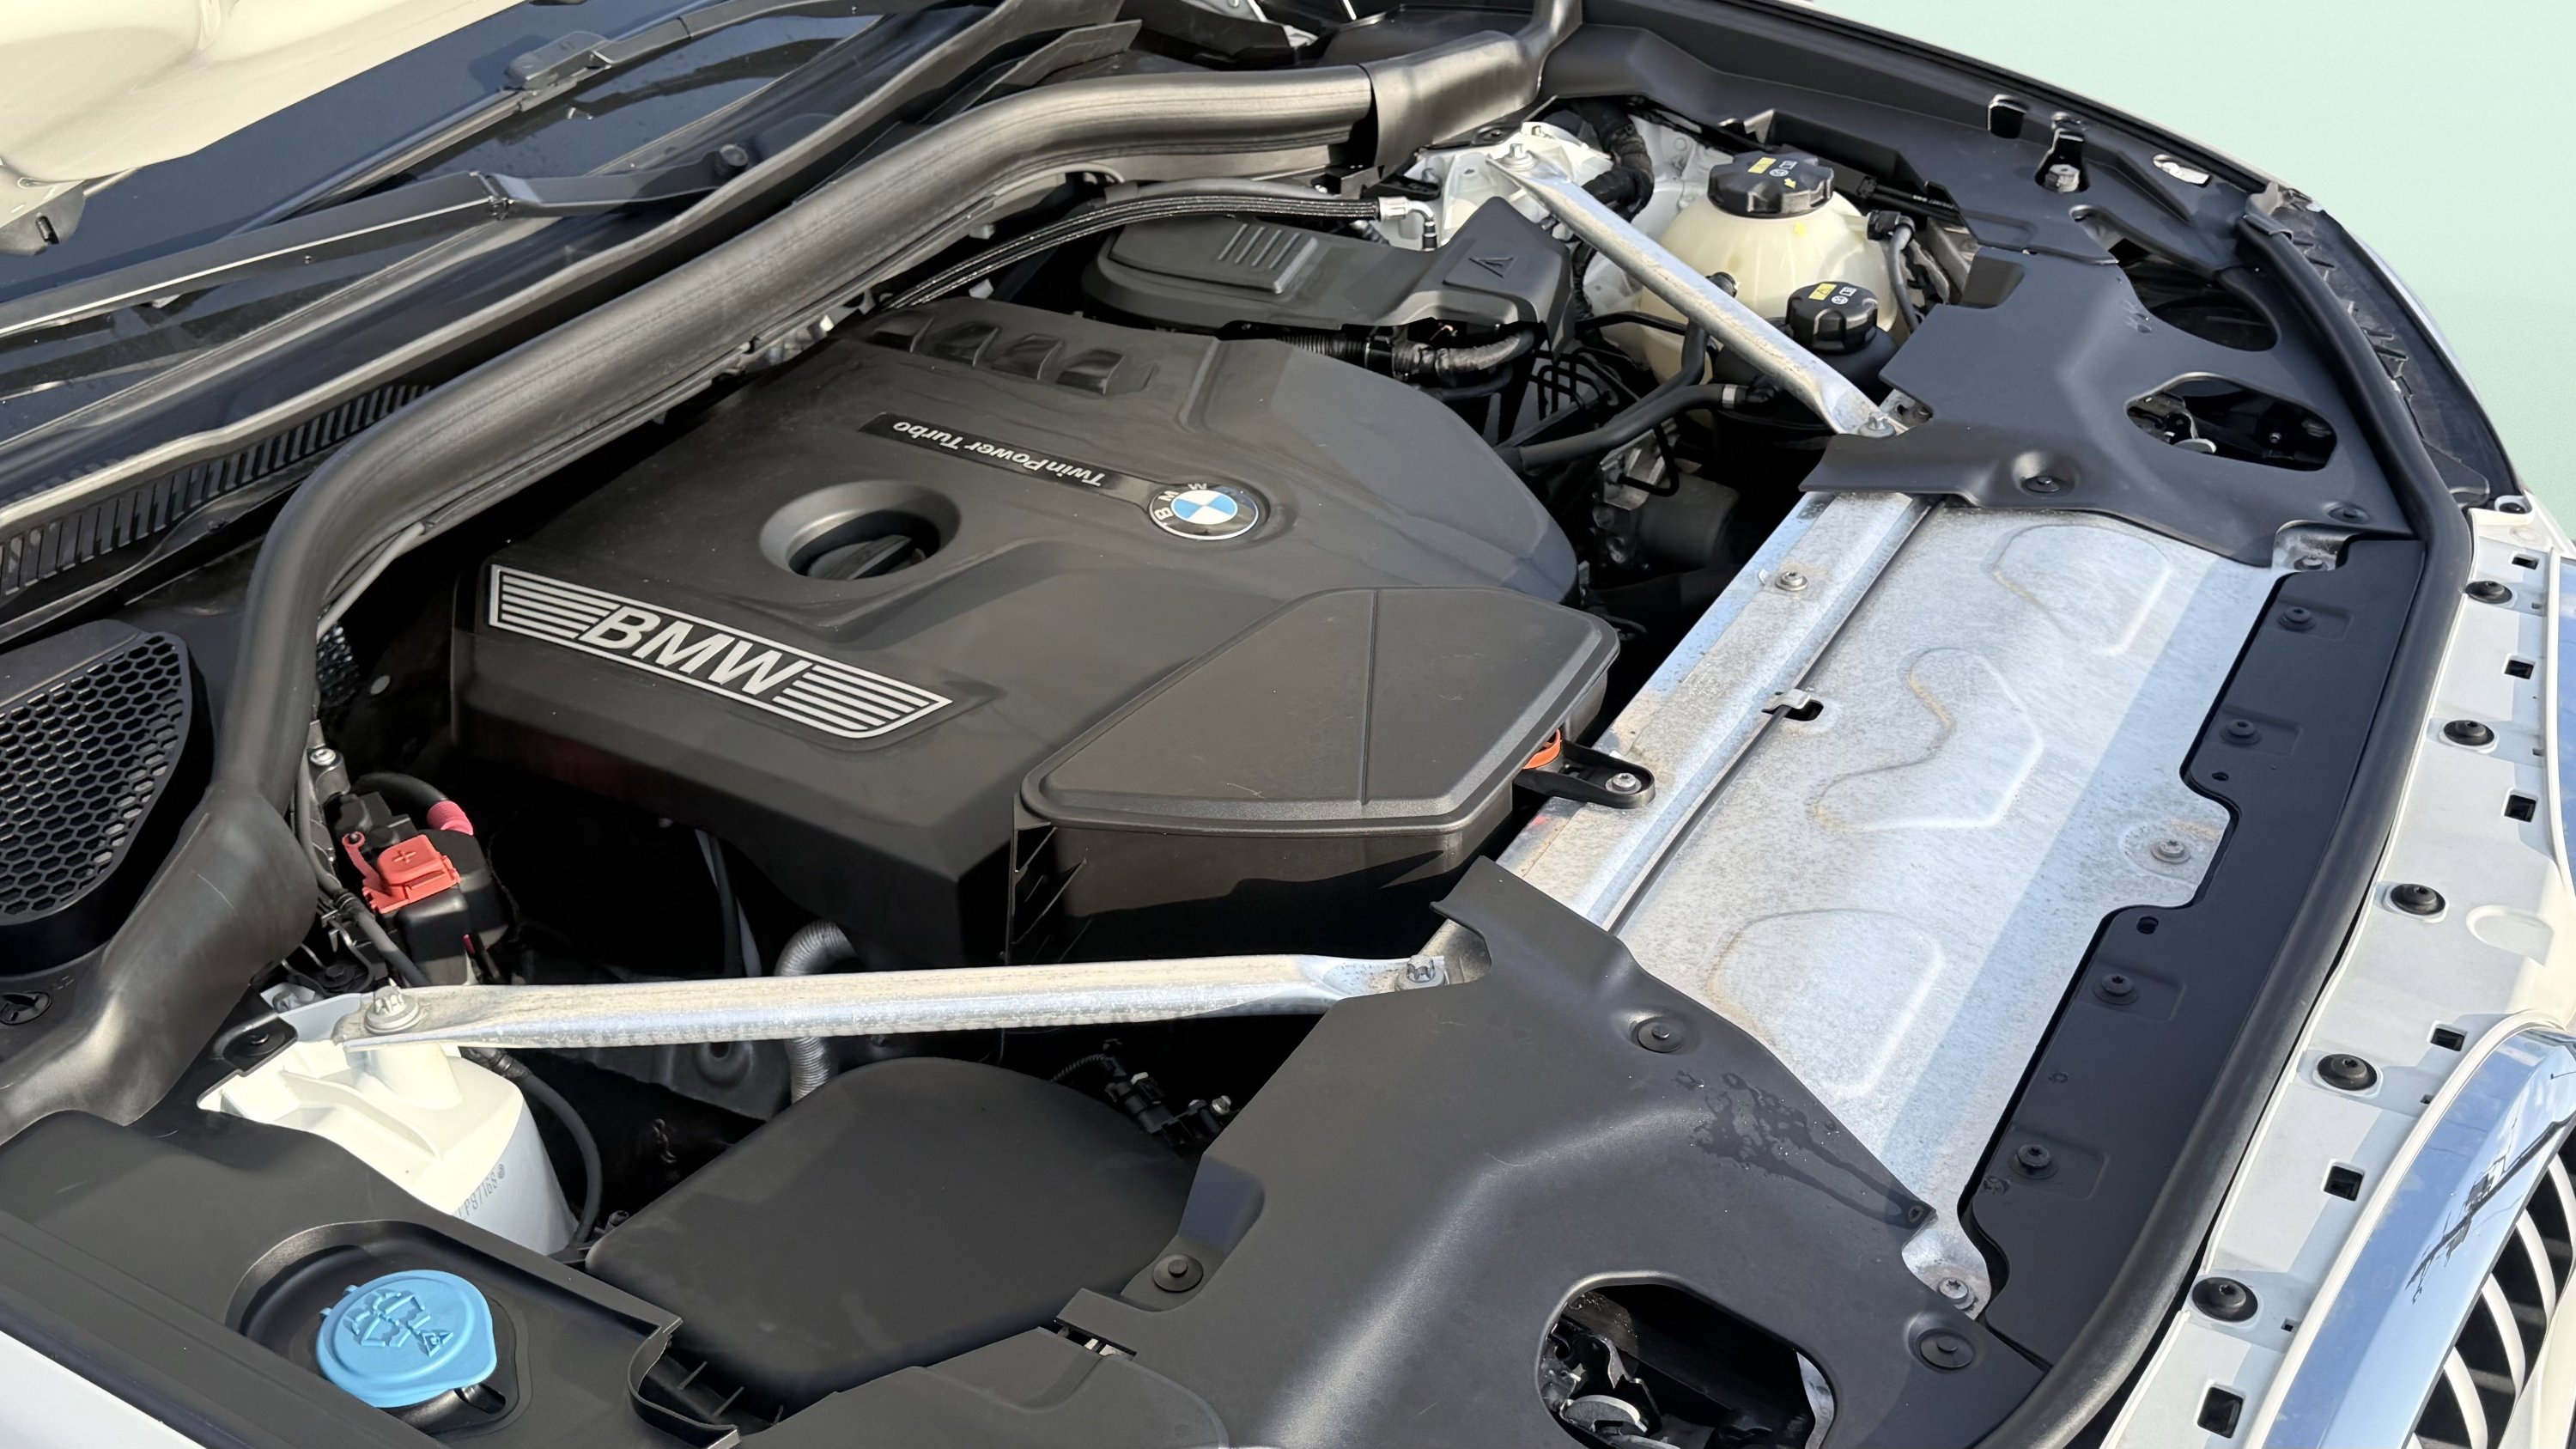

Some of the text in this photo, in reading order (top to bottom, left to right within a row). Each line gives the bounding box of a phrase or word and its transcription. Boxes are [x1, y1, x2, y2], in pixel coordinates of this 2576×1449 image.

[893, 422, 1105, 486] TwinPower Turbo
[1154, 483, 1207, 521] BMW
[578, 606, 813, 695] BMW
